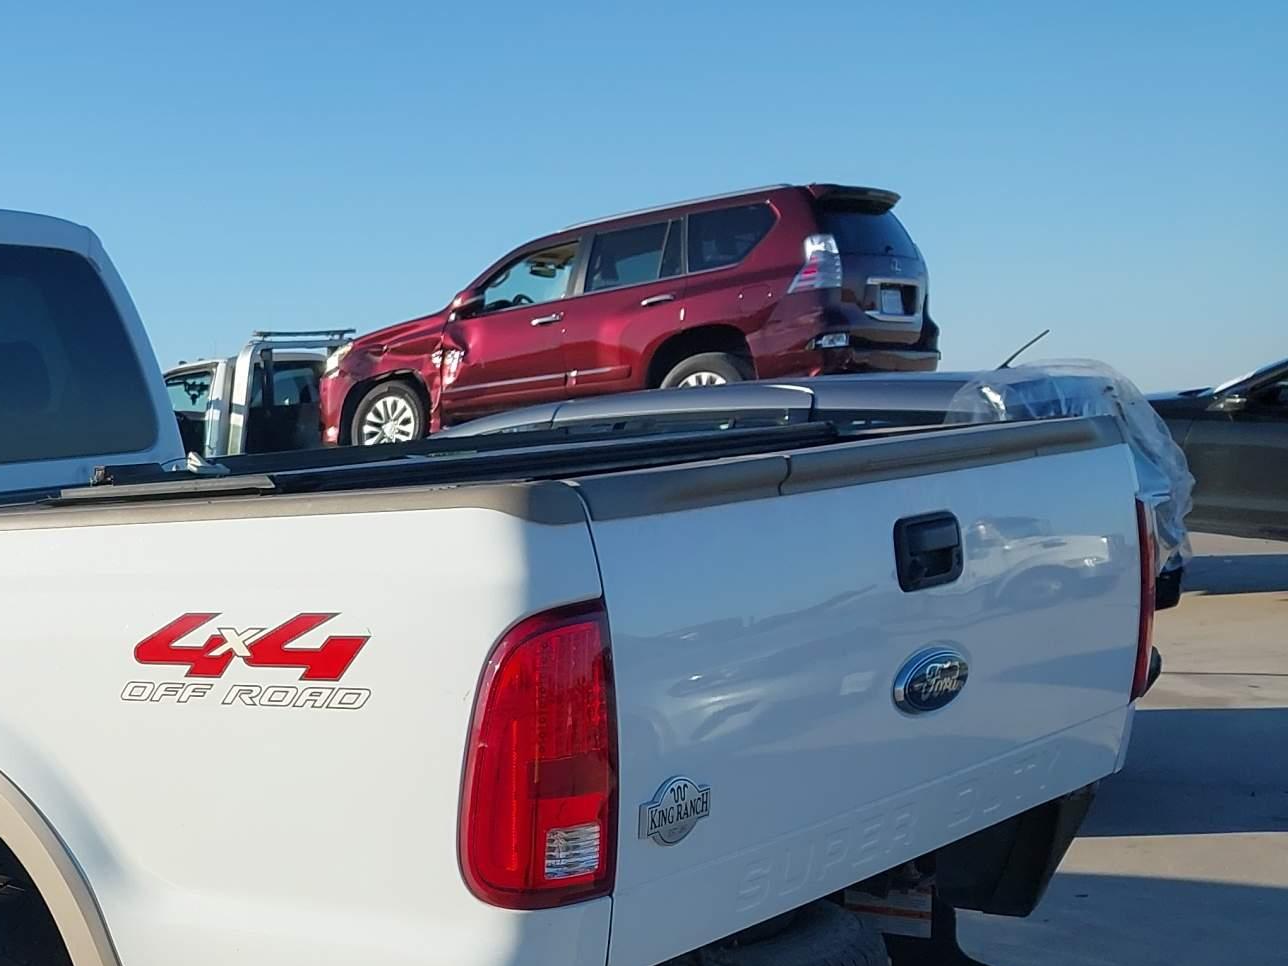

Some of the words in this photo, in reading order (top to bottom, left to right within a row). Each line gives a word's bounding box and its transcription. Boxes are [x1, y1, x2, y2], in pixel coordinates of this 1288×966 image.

[120, 681, 214, 703] OFF
[221, 685, 372, 710] ROAD
[650, 806, 675, 831] KING
[676, 791, 709, 822] RANCH
